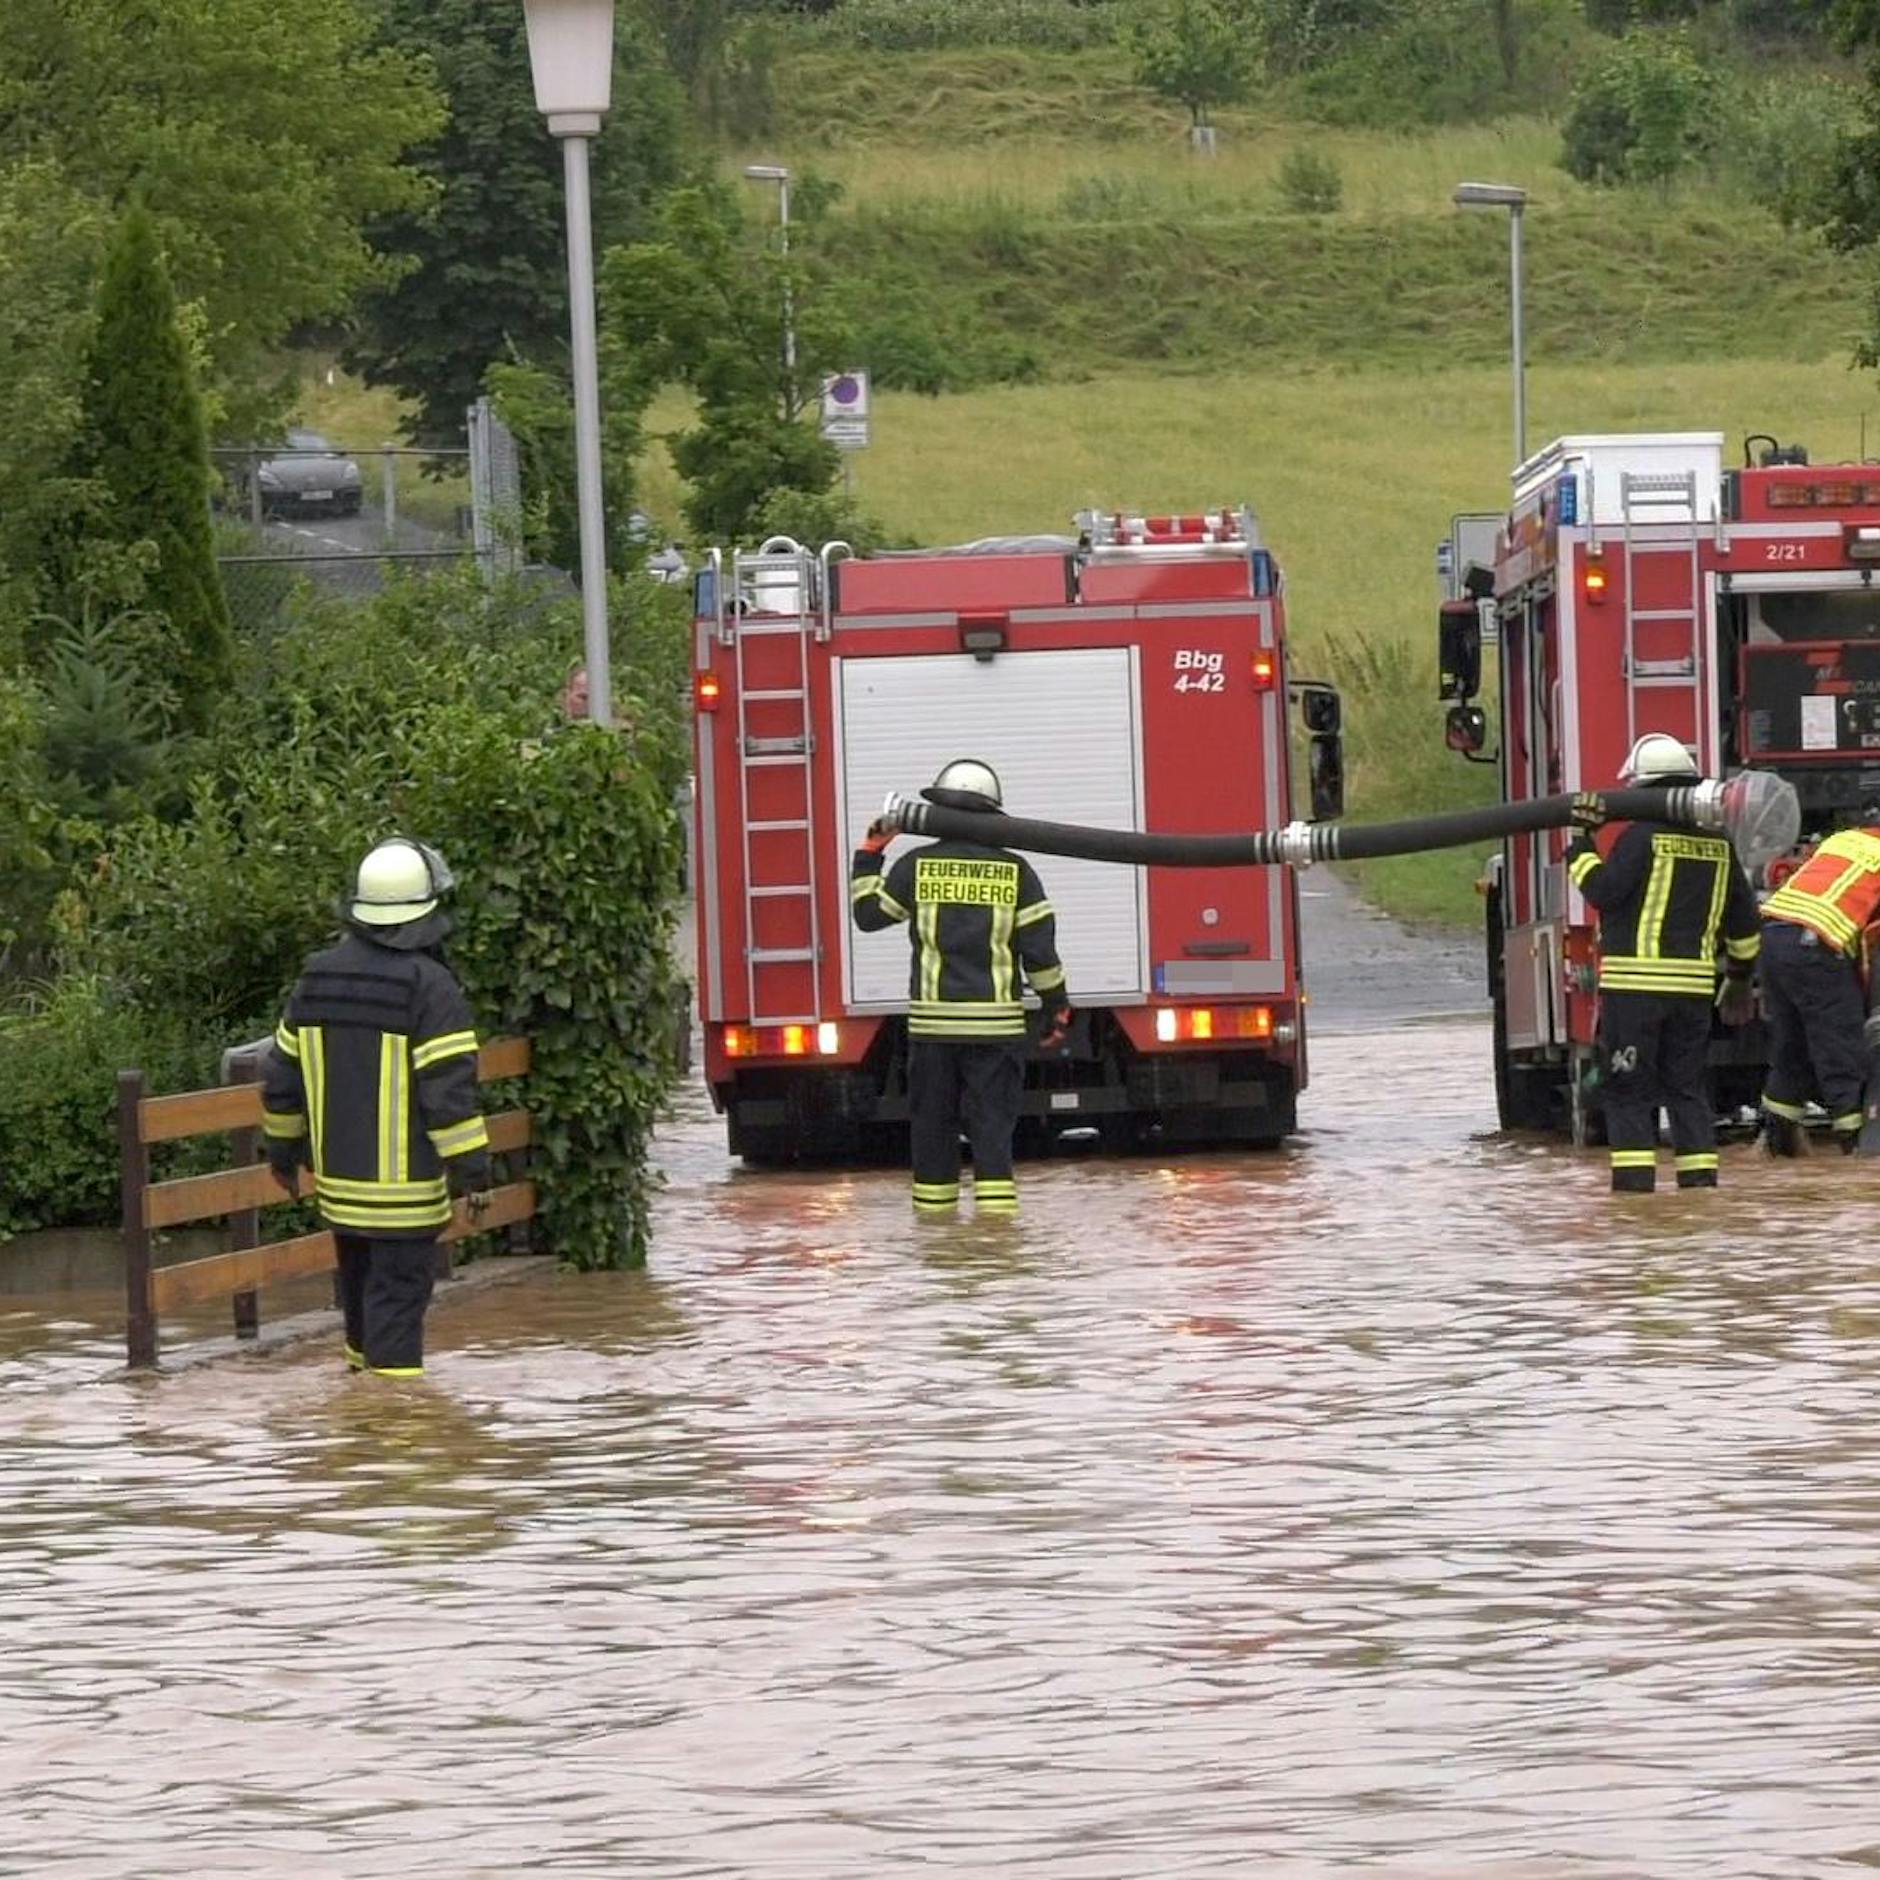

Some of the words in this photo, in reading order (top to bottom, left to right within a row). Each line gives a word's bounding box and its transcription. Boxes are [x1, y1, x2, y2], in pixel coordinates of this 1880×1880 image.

[1766, 544, 1804, 560] 2/21
[1174, 650, 1224, 672] Bbg
[1174, 673, 1225, 692] 4-42
[919, 861, 1015, 881] FEUERWEHR
[919, 882, 1015, 904] BREUBERG
